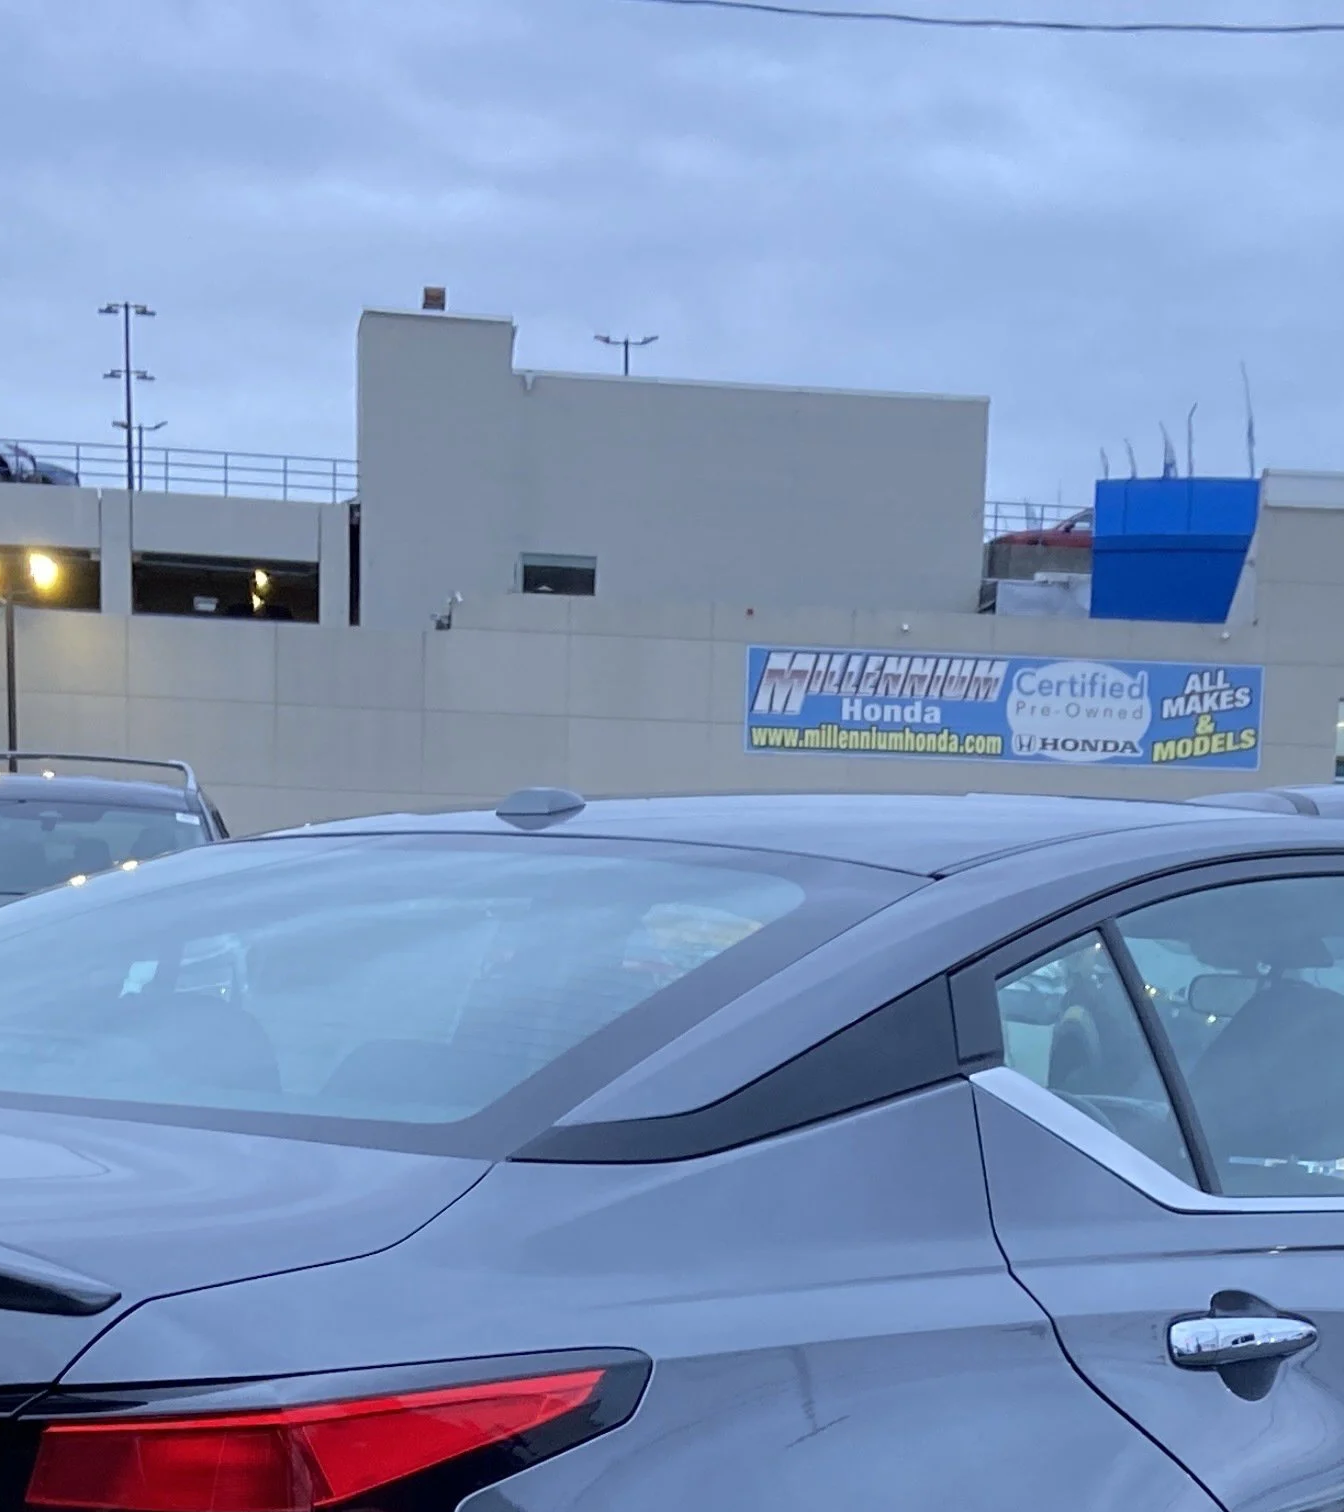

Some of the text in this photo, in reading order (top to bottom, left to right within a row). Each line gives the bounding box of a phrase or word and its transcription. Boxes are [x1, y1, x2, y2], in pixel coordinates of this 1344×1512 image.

[752, 651, 1009, 715] MILLENNIUM
[1015, 670, 1146, 700] Certified
[1184, 669, 1231, 695] ALL
[841, 698, 942, 725] Honda
[1015, 702, 1144, 720] Pre-Owned
[1161, 686, 1253, 719] MAKES
[1196, 714, 1215, 735] &
[751, 724, 1003, 755] www.millenniumhonda.com
[1040, 737, 1142, 754] HONDA
[1152, 728, 1257, 762] MODELS
